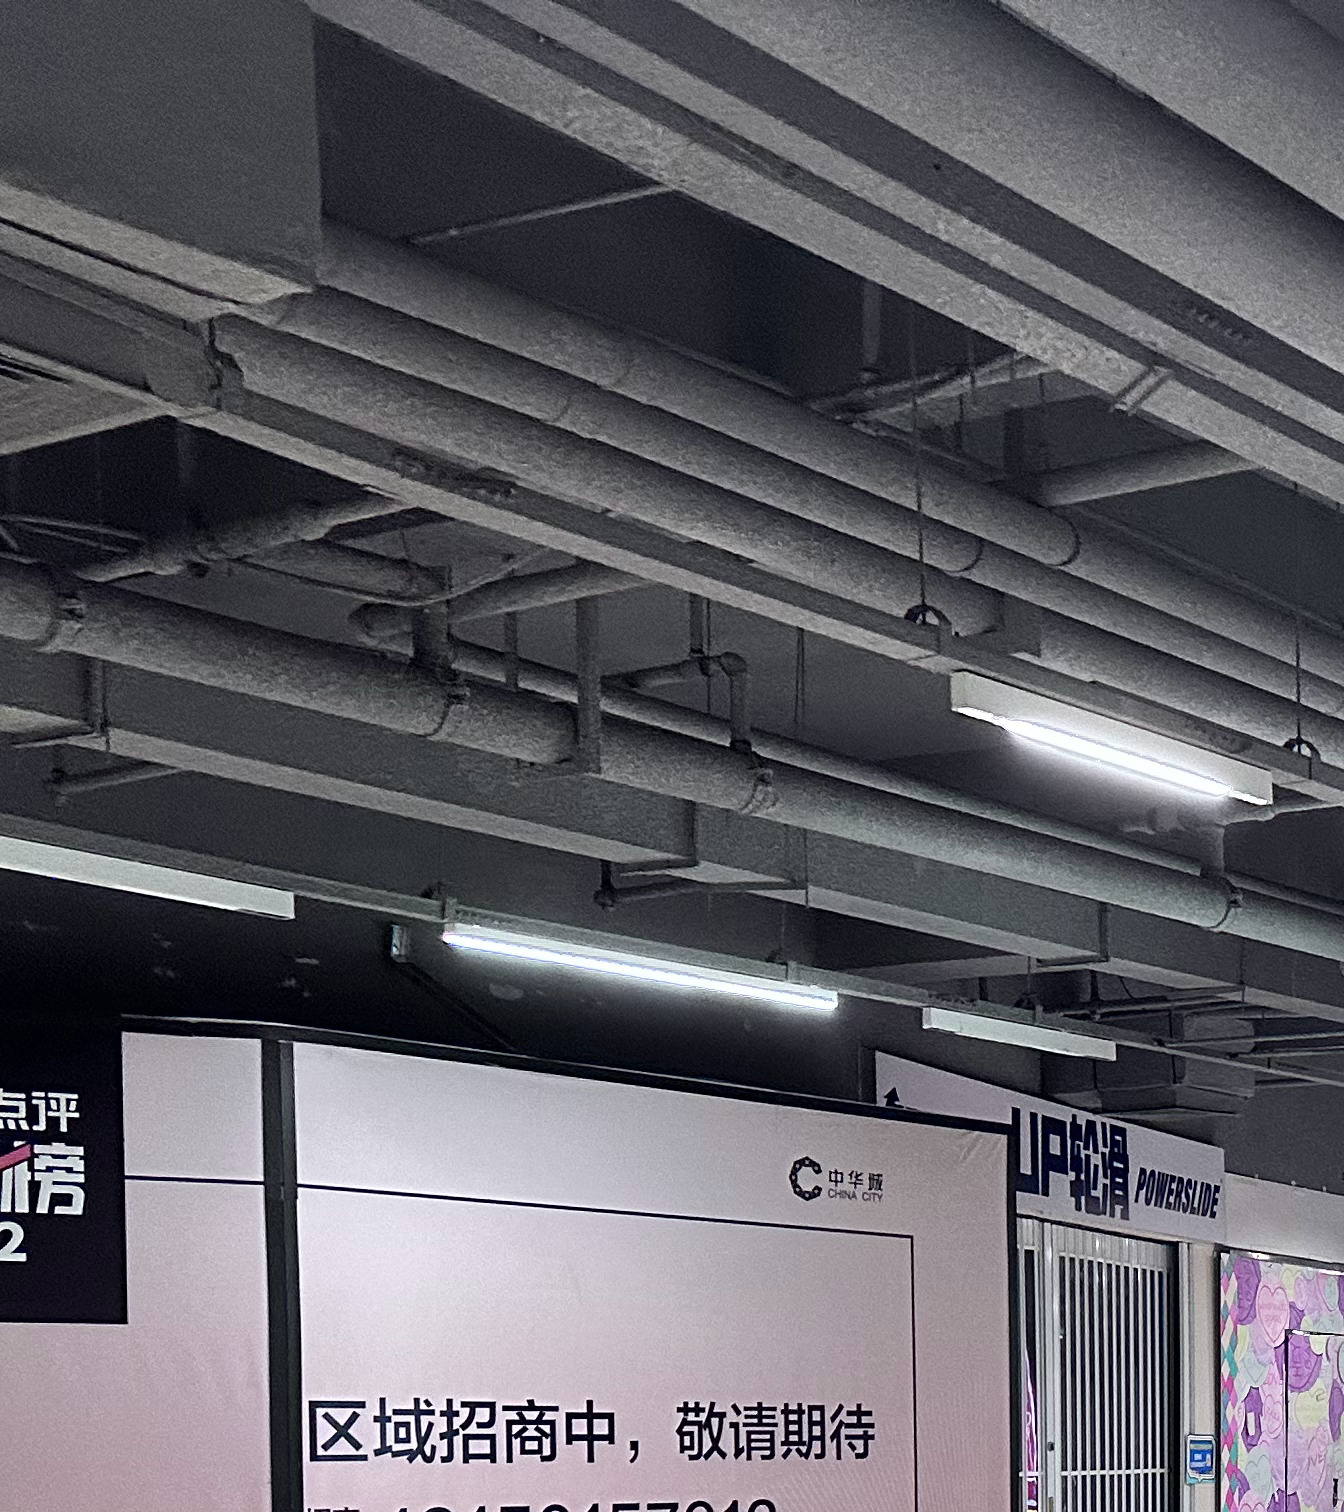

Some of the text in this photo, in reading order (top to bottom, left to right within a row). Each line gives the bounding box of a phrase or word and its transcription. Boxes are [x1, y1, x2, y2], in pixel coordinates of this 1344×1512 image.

[827, 1188, 884, 1203] CHINA CITY
[1134, 1166, 1221, 1219] POWERSLIDE
[308, 1397, 877, 1465] 区域招商中，敬请期待
